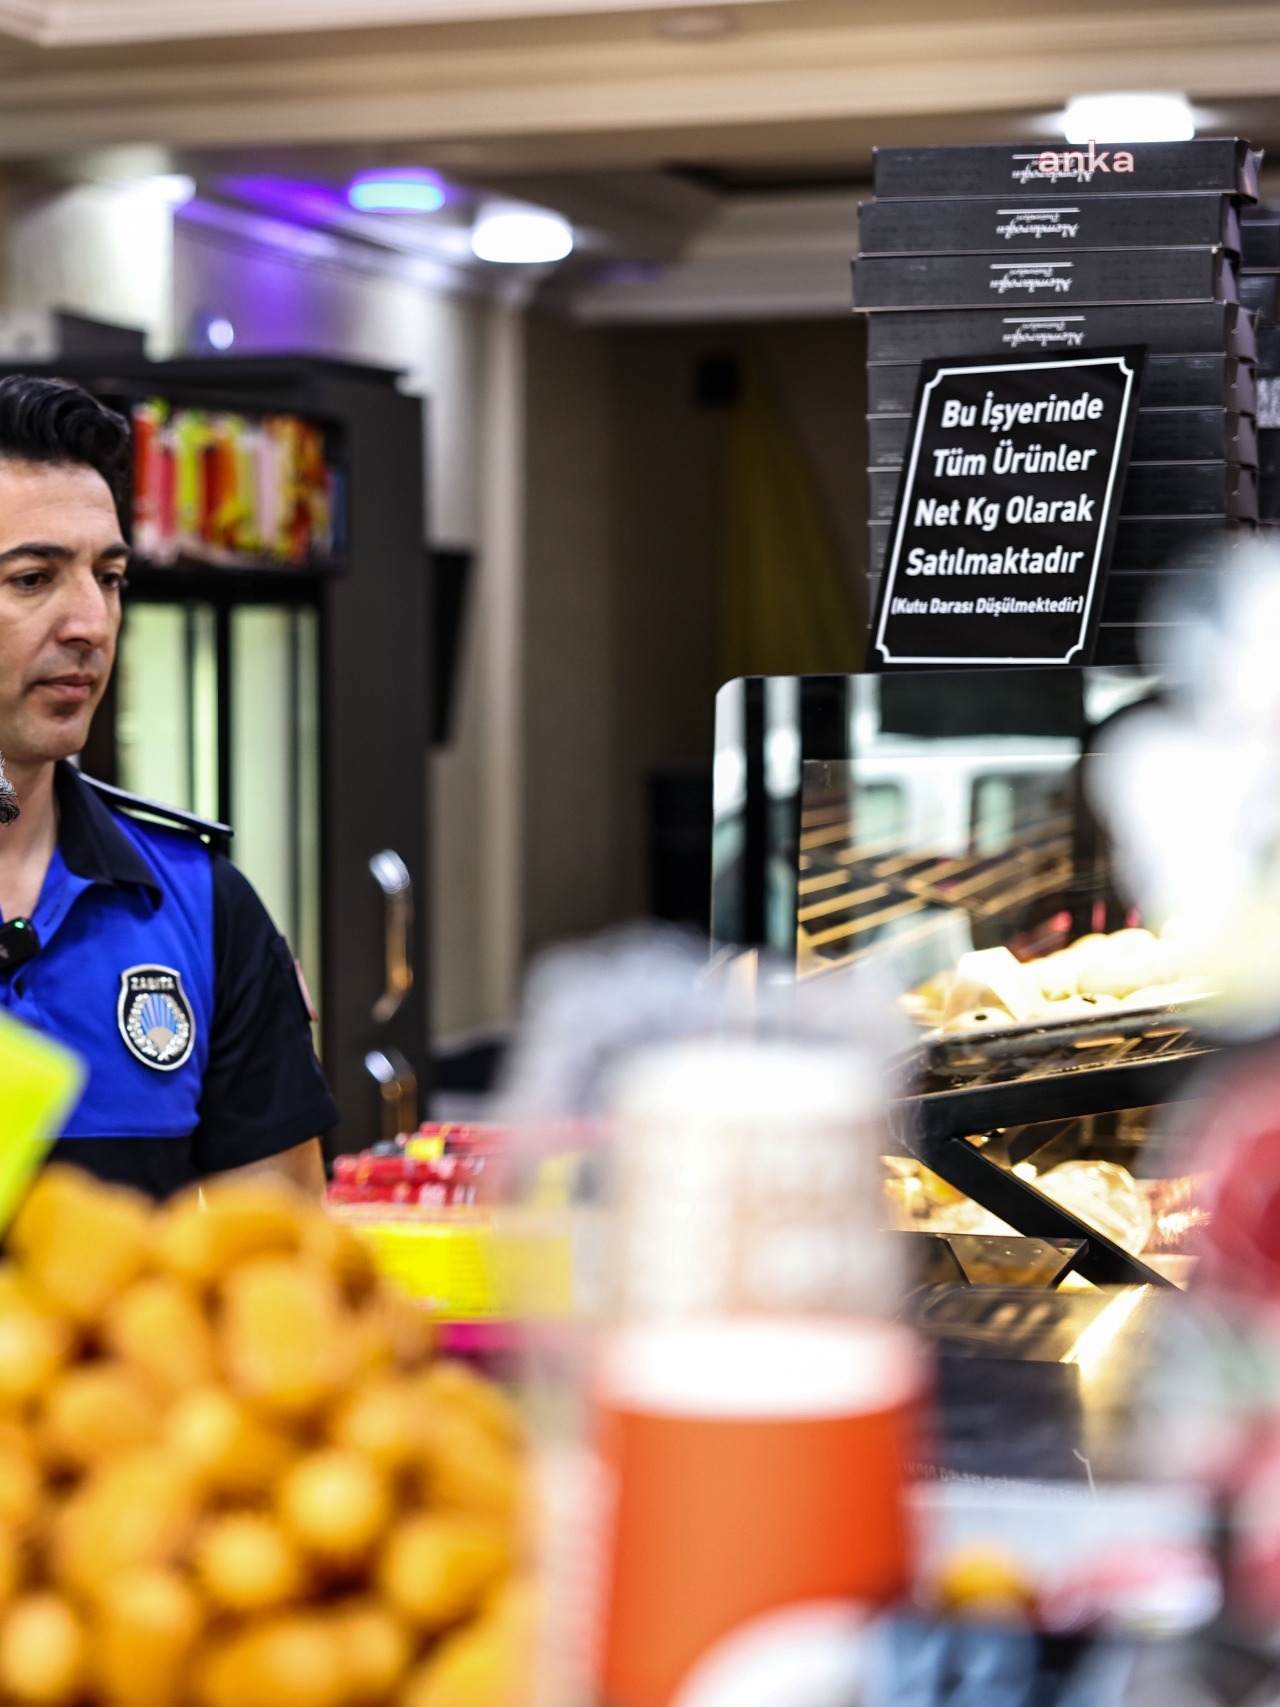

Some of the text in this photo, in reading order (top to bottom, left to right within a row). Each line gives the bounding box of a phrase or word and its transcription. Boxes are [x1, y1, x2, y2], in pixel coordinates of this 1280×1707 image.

[940, 390, 1104, 433] Bu İşyerinde
[933, 438, 1097, 477] Tüm Ürünler
[913, 493, 1095, 532] Net Kg Olarak
[904, 544, 1085, 577] Satılmaktadır
[891, 595, 1084, 618] (Kutu Darası Düşülmektedir)
